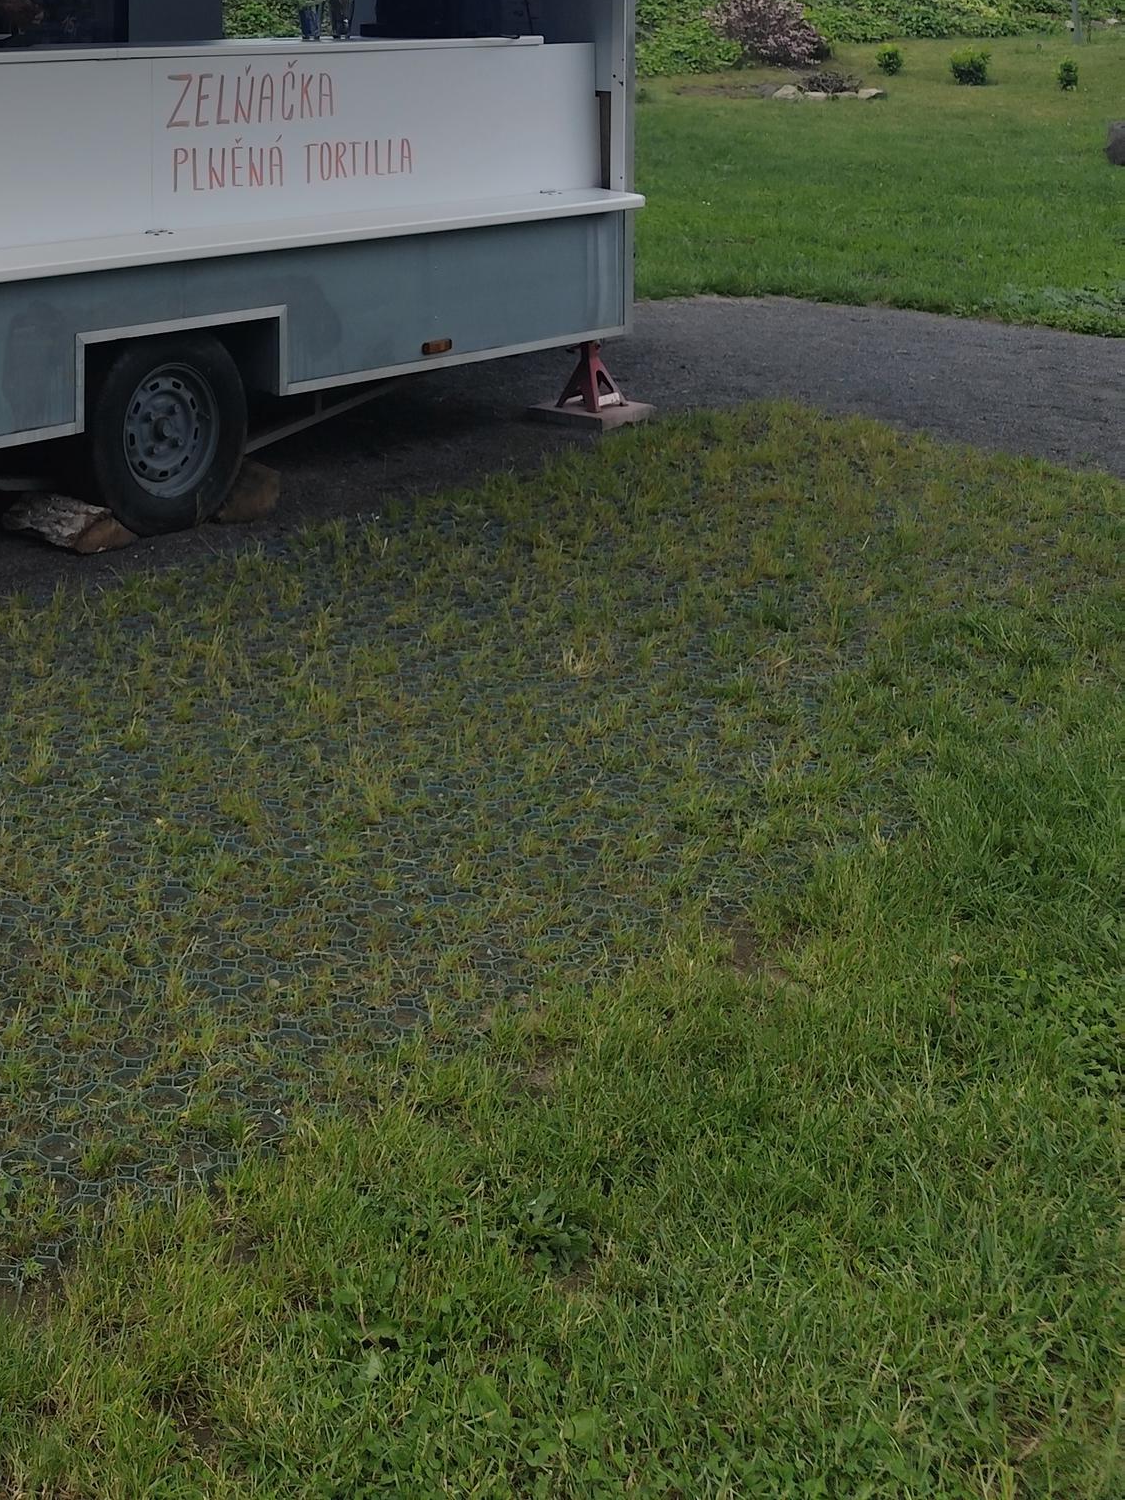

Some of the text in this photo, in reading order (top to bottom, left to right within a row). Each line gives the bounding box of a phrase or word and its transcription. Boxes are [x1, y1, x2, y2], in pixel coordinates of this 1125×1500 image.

[165, 59, 335, 129] ZELŇAČKA
[173, 134, 413, 193] PLNĚNÁ TORTILLA
